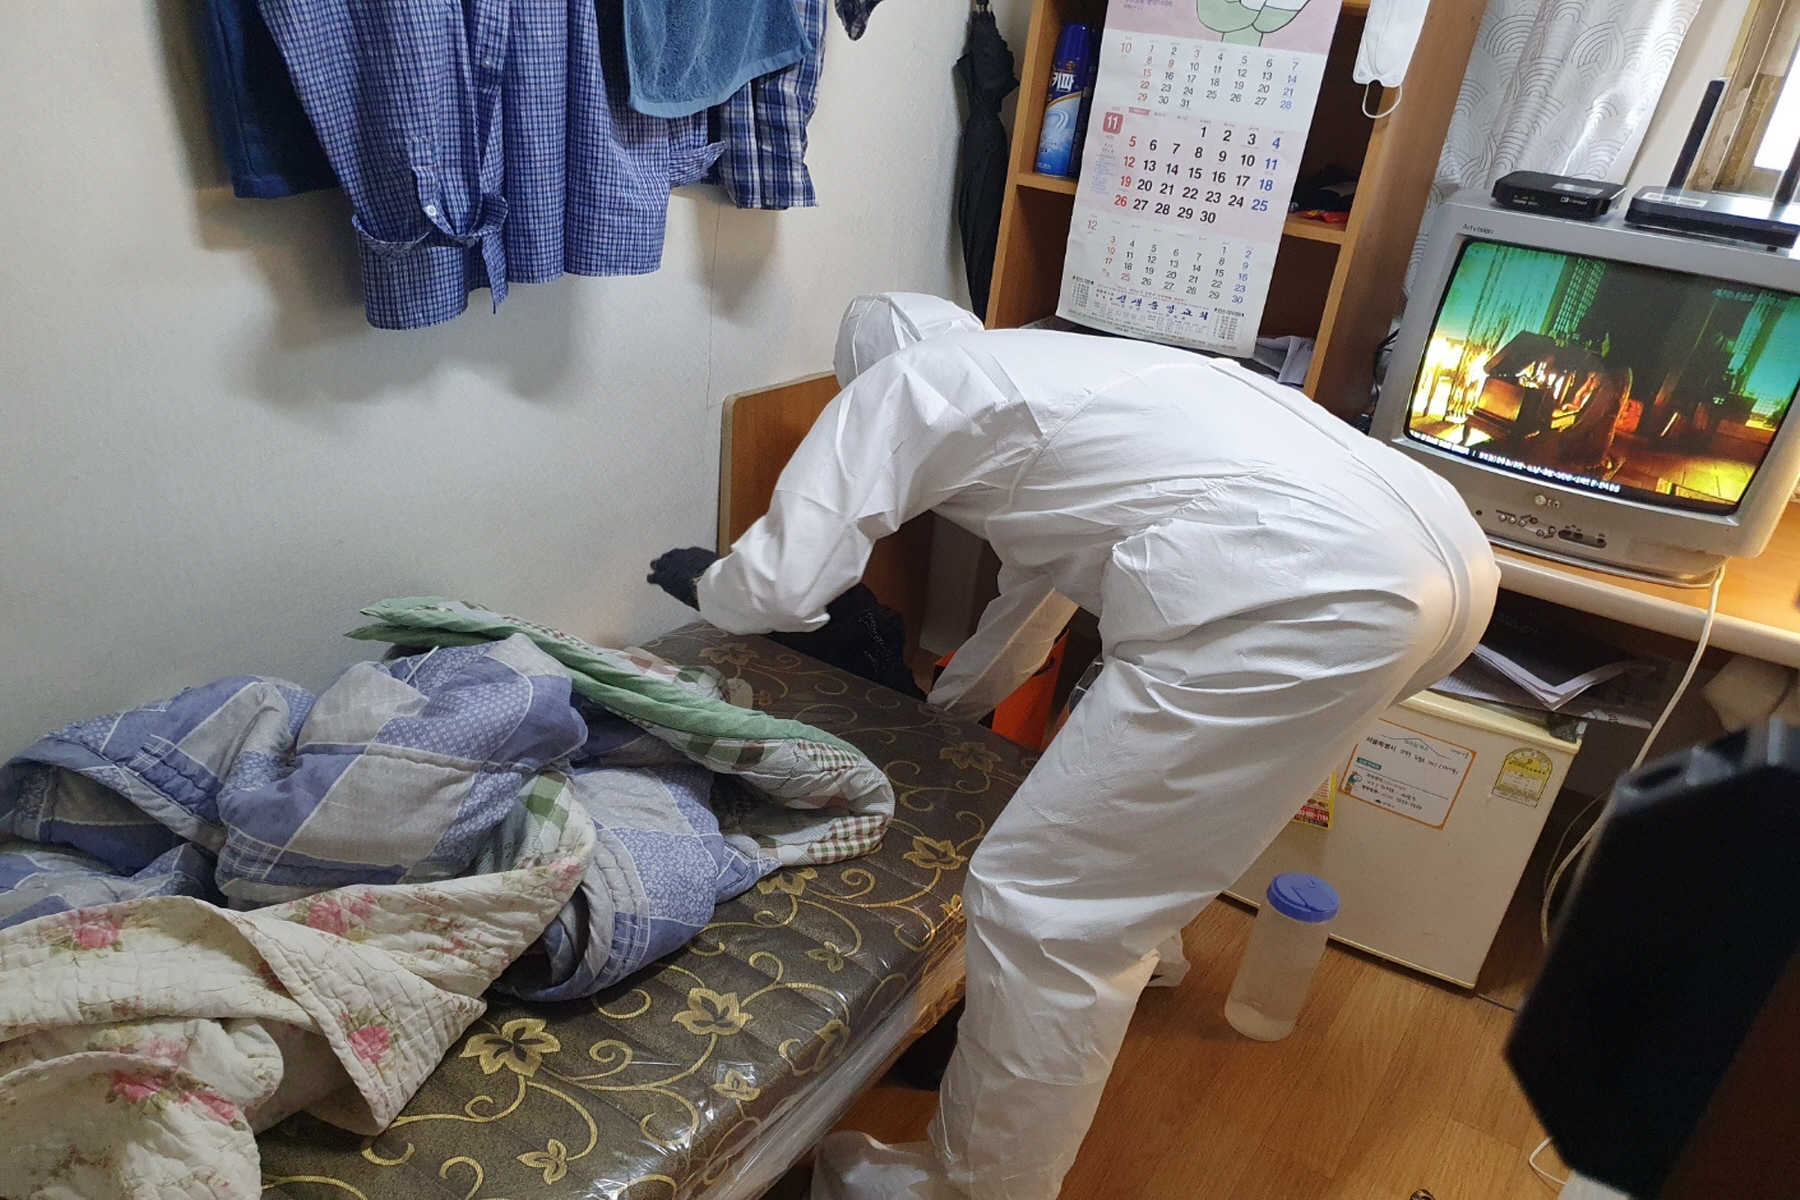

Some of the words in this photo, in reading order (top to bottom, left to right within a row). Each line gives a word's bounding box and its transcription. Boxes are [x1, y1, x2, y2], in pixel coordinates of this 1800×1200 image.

[1120, 43, 1132, 53] 10
[1171, 47, 1177, 55] 2
[1194, 50, 1200, 58] 3
[1218, 53, 1223, 61] 4
[1241, 56, 1247, 64] 5
[1266, 59, 1272, 67] 6
[1292, 62, 1299, 70] 7
[1165, 72, 1174, 80] 16
[1187, 75, 1196, 83] 17
[1210, 78, 1219, 86] 18
[1234, 81, 1244, 89] 19
[1258, 84, 1270, 93] 20
[1283, 88, 1294, 97] 21
[1168, 59, 1174, 67] 9
[1237, 69, 1247, 77] 12
[1262, 72, 1272, 80] 13
[1287, 75, 1297, 84] 14
[1137, 93, 1147, 101] 29
[1158, 96, 1169, 104] 30
[1180, 99, 1190, 107] 31
[1140, 81, 1150, 89] 22
[1161, 84, 1171, 92] 23
[1183, 87, 1194, 95] 24
[1206, 90, 1217, 99] 25
[1230, 94, 1241, 102] 26
[1255, 97, 1267, 106] 27
[1280, 101, 1291, 109] 28
[1107, 116, 1118, 130] 11
[1201, 127, 1207, 137] 1
[1223, 130, 1232, 142] 2
[1247, 134, 1256, 145] 3
[1272, 137, 1281, 149] 4
[1129, 136, 1137, 147] 5
[1149, 140, 1157, 151] 6
[1173, 143, 1180, 154] 7
[1195, 147, 1203, 158] 8
[1219, 151, 1227, 162] 9
[1241, 154, 1255, 167] 10
[1265, 159, 1278, 170] 11
[1123, 156, 1135, 167] 12
[1143, 160, 1156, 171] 13
[1166, 163, 1179, 175] 14
[1188, 168, 1202, 179] 15
[1212, 171, 1226, 183] 16
[1236, 175, 1250, 186] 17
[1259, 179, 1273, 191] 18
[1120, 176, 1132, 186] 19
[1137, 179, 1152, 191] 20
[1160, 183, 1175, 195] 21
[1182, 187, 1198, 199] 22
[1205, 191, 1221, 203] 23
[1228, 195, 1244, 207] 24
[1251, 199, 1268, 211] 25
[1114, 195, 1127, 207] 26
[1133, 199, 1148, 211] 27
[1154, 203, 1170, 215] 28
[1177, 207, 1193, 219] 29
[1200, 211, 1216, 223] 30
[1087, 220, 1098, 230] 12
[1107, 247, 1115, 255] 10
[1170, 260, 1179, 268] 13
[1192, 264, 1201, 272] 14
[1238, 273, 1248, 281] 16
[1121, 273, 1131, 281] 25
[1163, 282, 1174, 290] 27
[1186, 287, 1197, 295] 28
[1208, 291, 1220, 299] 29
[1232, 295, 1243, 304] 30
[1145, 267, 1154, 275] 19
[1166, 271, 1176, 279] 20
[1211, 280, 1222, 288] 22
[1234, 284, 1246, 292] 23
